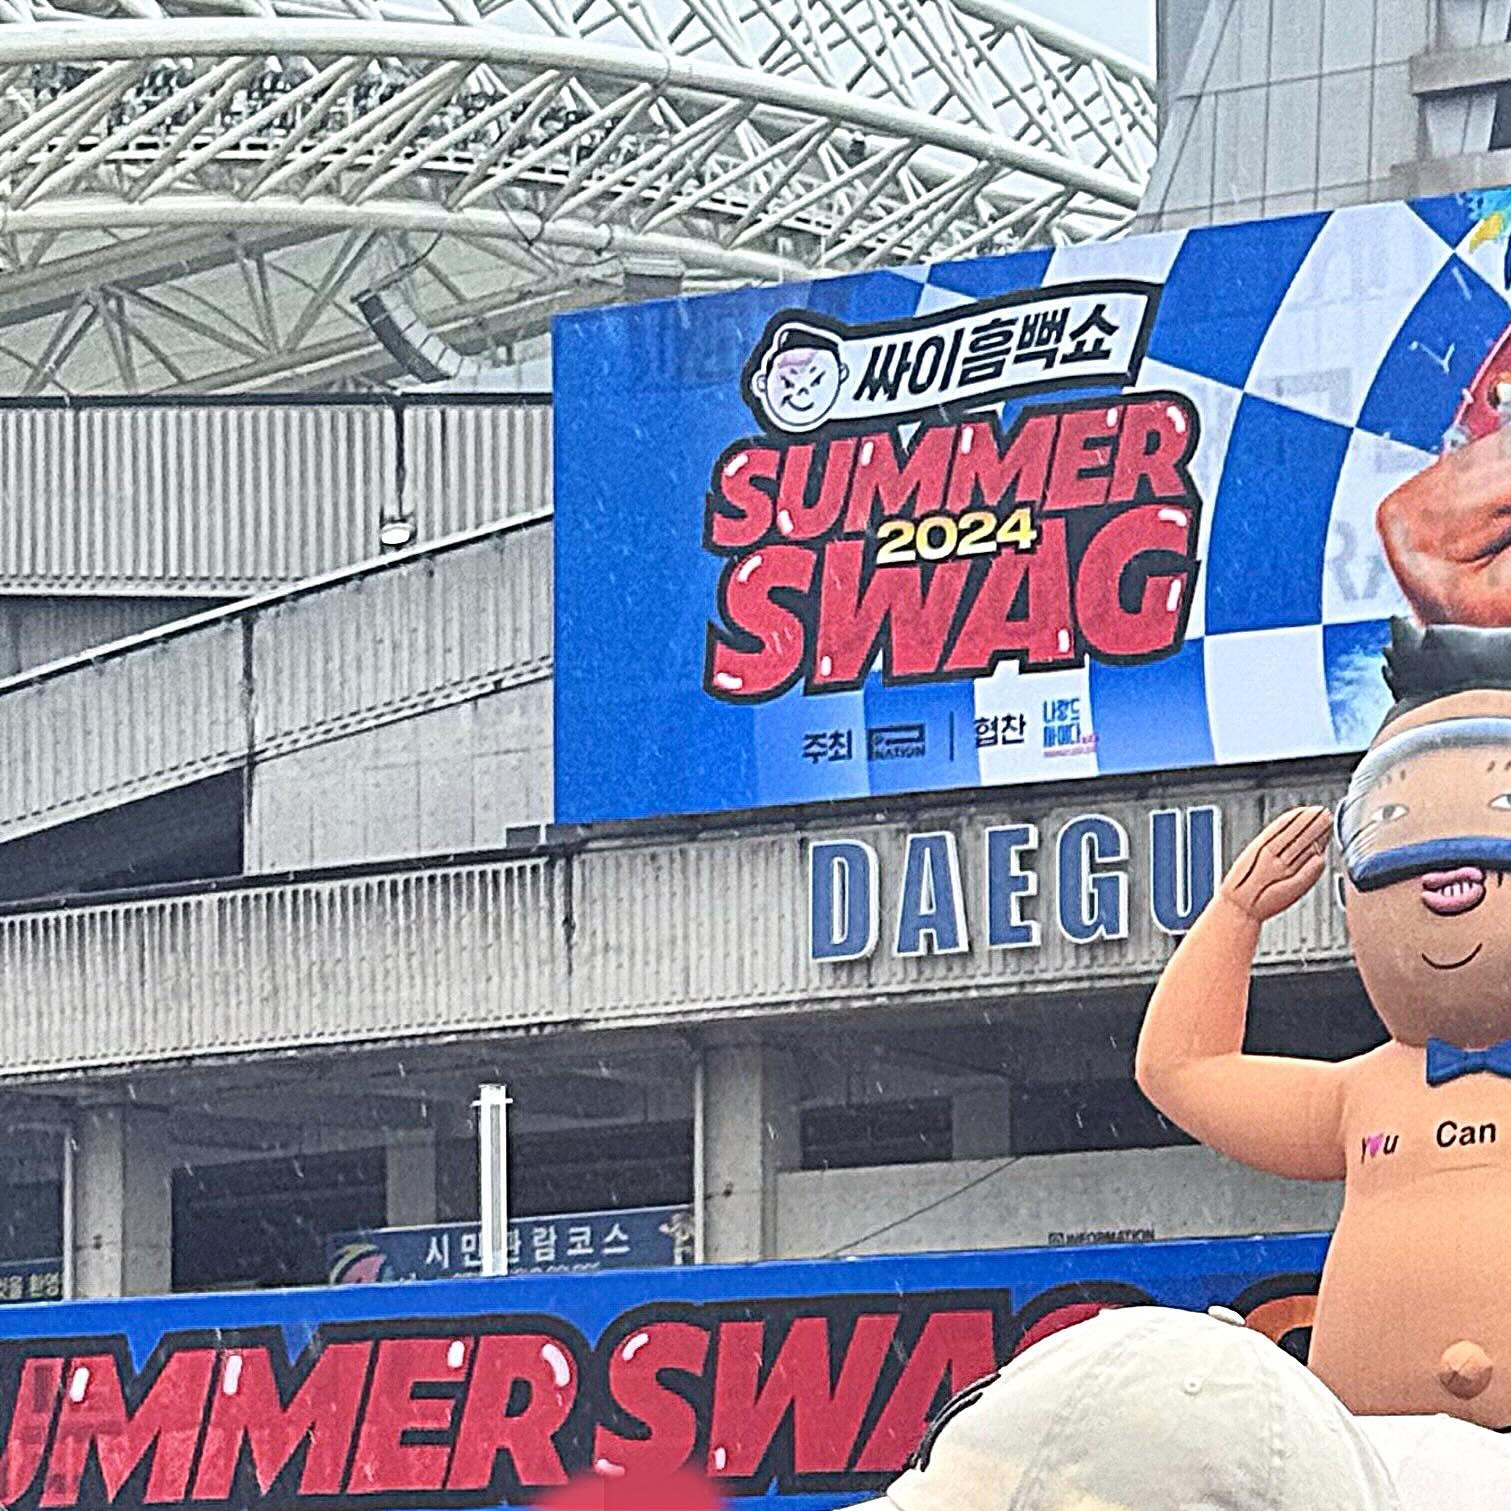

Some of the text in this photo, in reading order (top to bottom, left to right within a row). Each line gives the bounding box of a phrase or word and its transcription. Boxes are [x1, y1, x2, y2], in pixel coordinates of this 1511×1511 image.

[853, 303, 1119, 401] 싸이흠뻑쇼
[711, 400, 1194, 549] SUMMER
[876, 507, 1037, 564] 2024
[711, 509, 1197, 697] SWAG
[802, 729, 852, 764] 주최
[975, 713, 1027, 748] 협찬
[809, 806, 1222, 962] DAEGU
[1436, 1120, 1497, 1148] Can
[595, 1303, 1118, 1479] SWA
